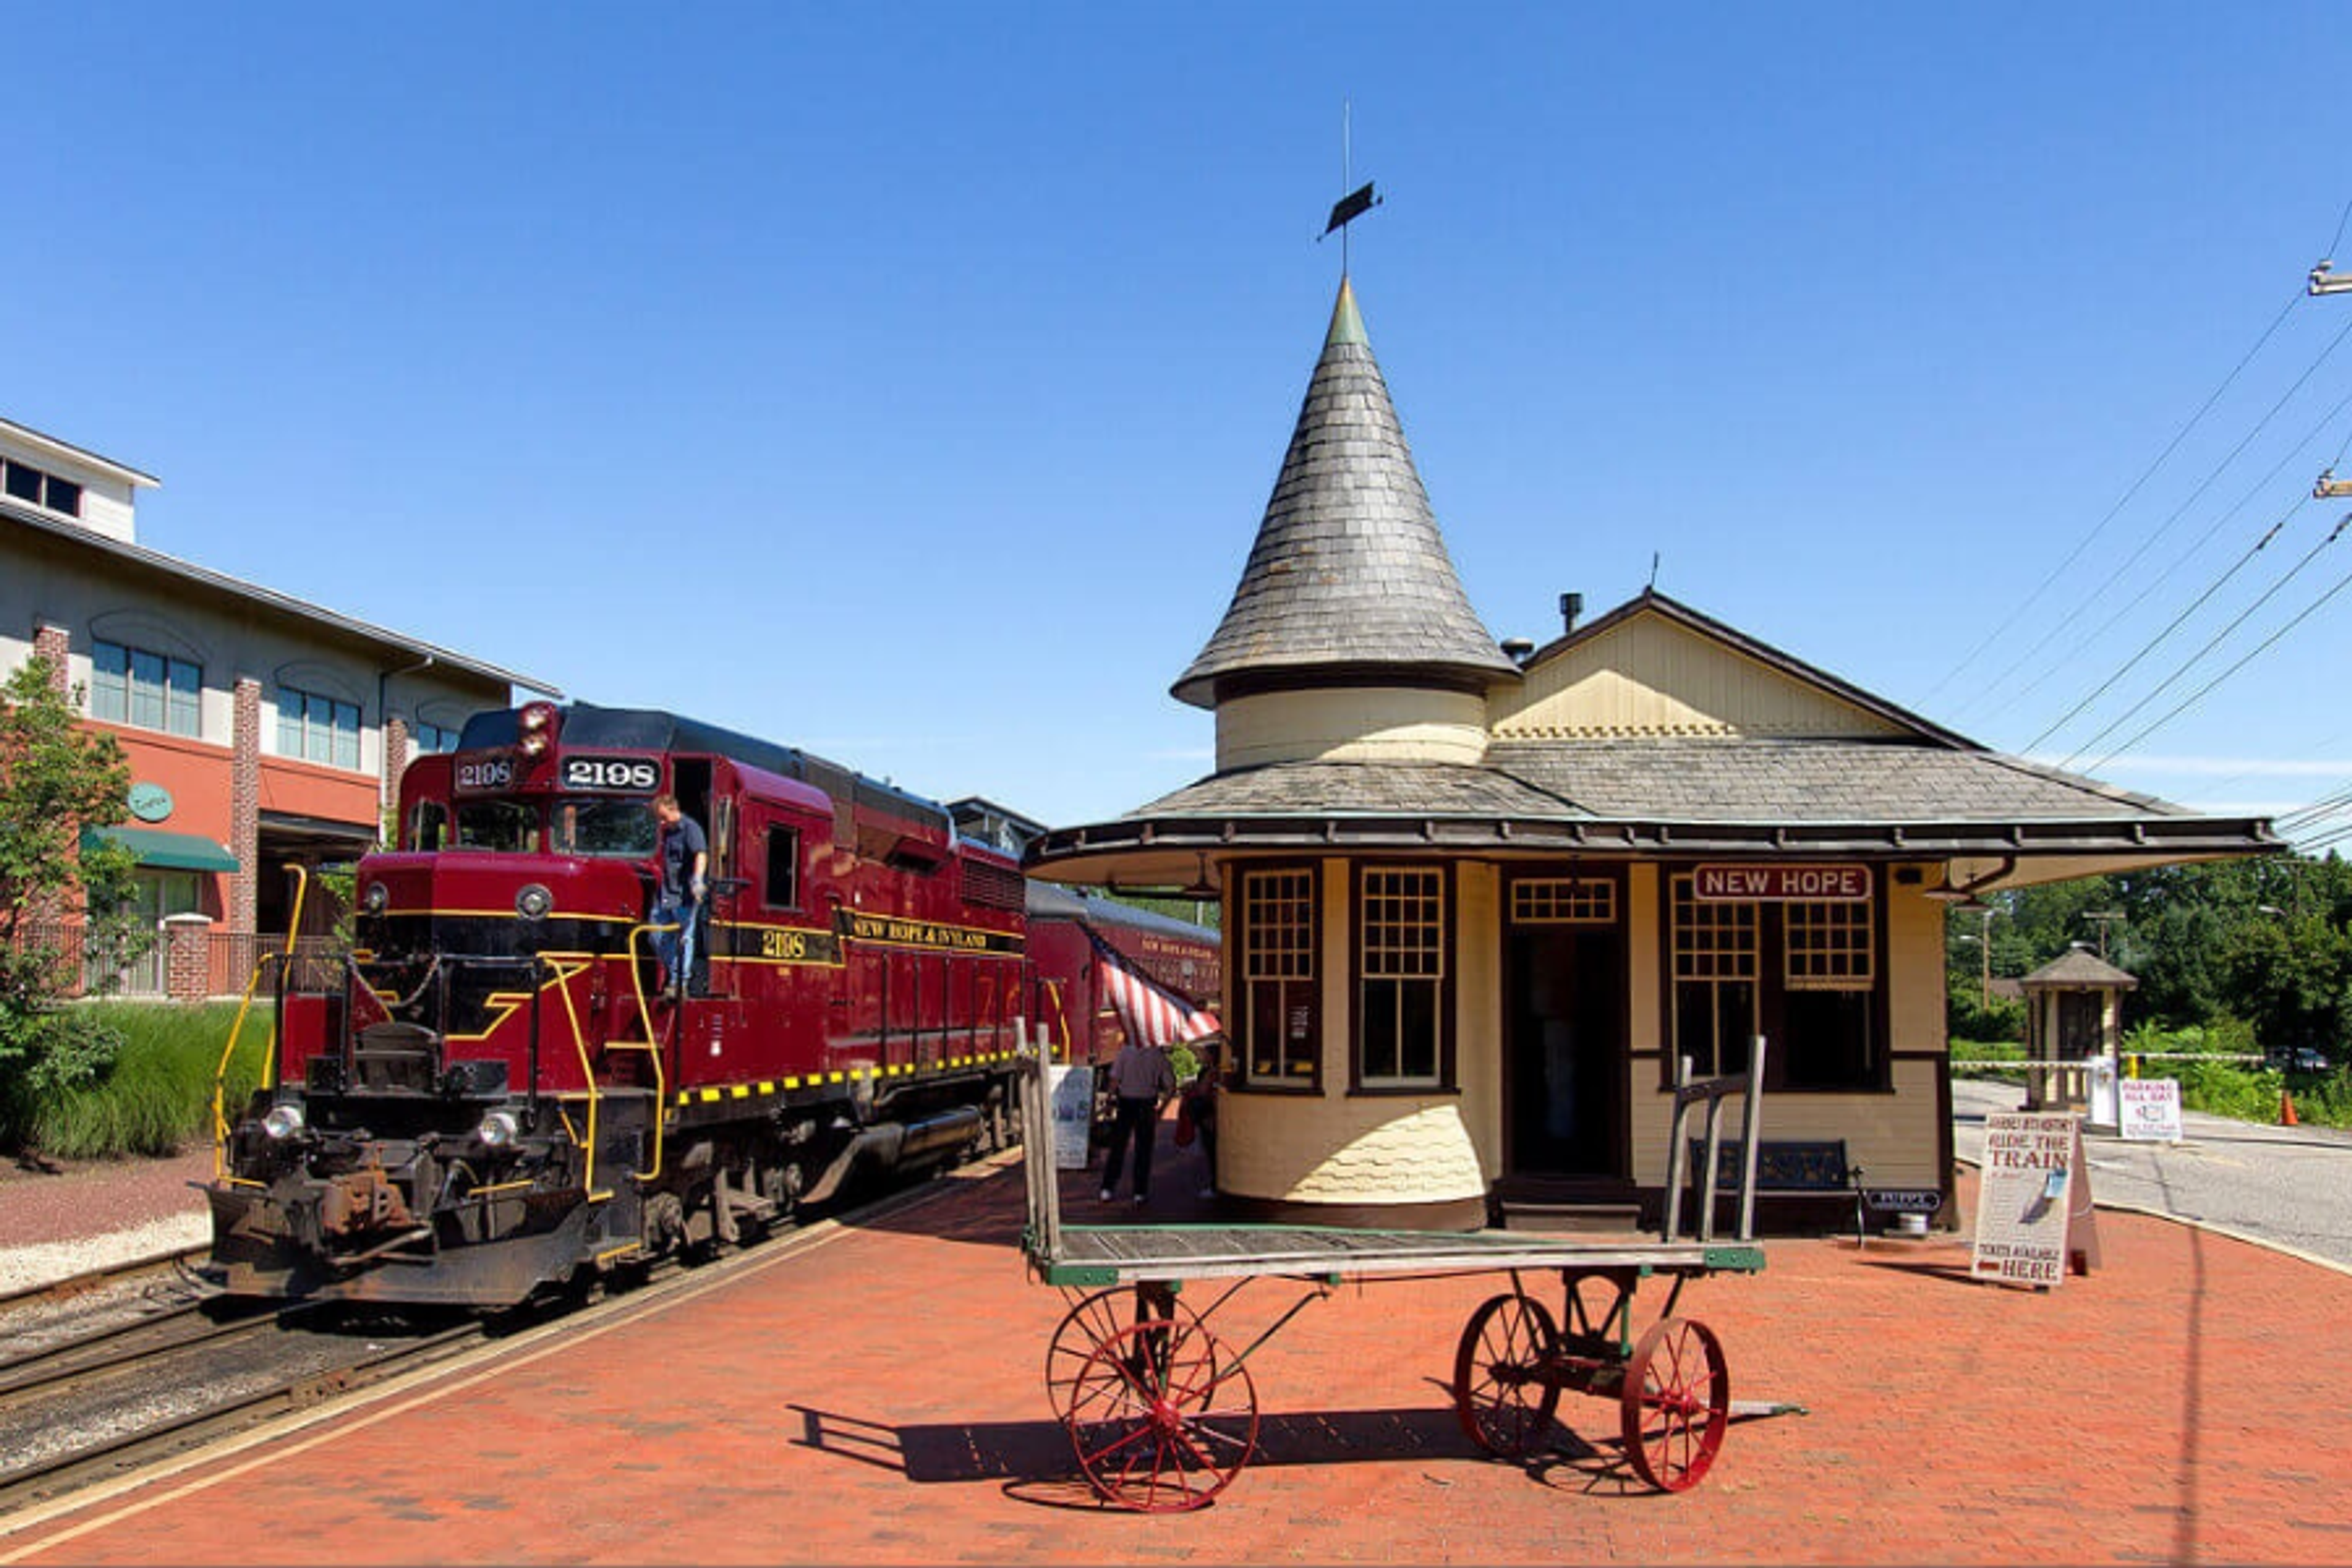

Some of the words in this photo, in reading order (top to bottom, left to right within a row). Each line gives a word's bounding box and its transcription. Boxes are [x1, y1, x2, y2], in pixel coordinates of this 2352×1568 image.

[459, 761, 511, 786] 2198
[567, 761, 655, 787] 2198
[1705, 870, 1769, 893] NEW
[1781, 870, 1858, 894] HOPE
[854, 919, 887, 937] NEW
[888, 922, 924, 943] HOPE
[762, 930, 806, 959] 2198
[1989, 1134, 2032, 1148] RIDE
[2035, 1134, 2069, 1150] THE
[1989, 1150, 2068, 1169] TRAIN
[2002, 1259, 2059, 1281] HERE
